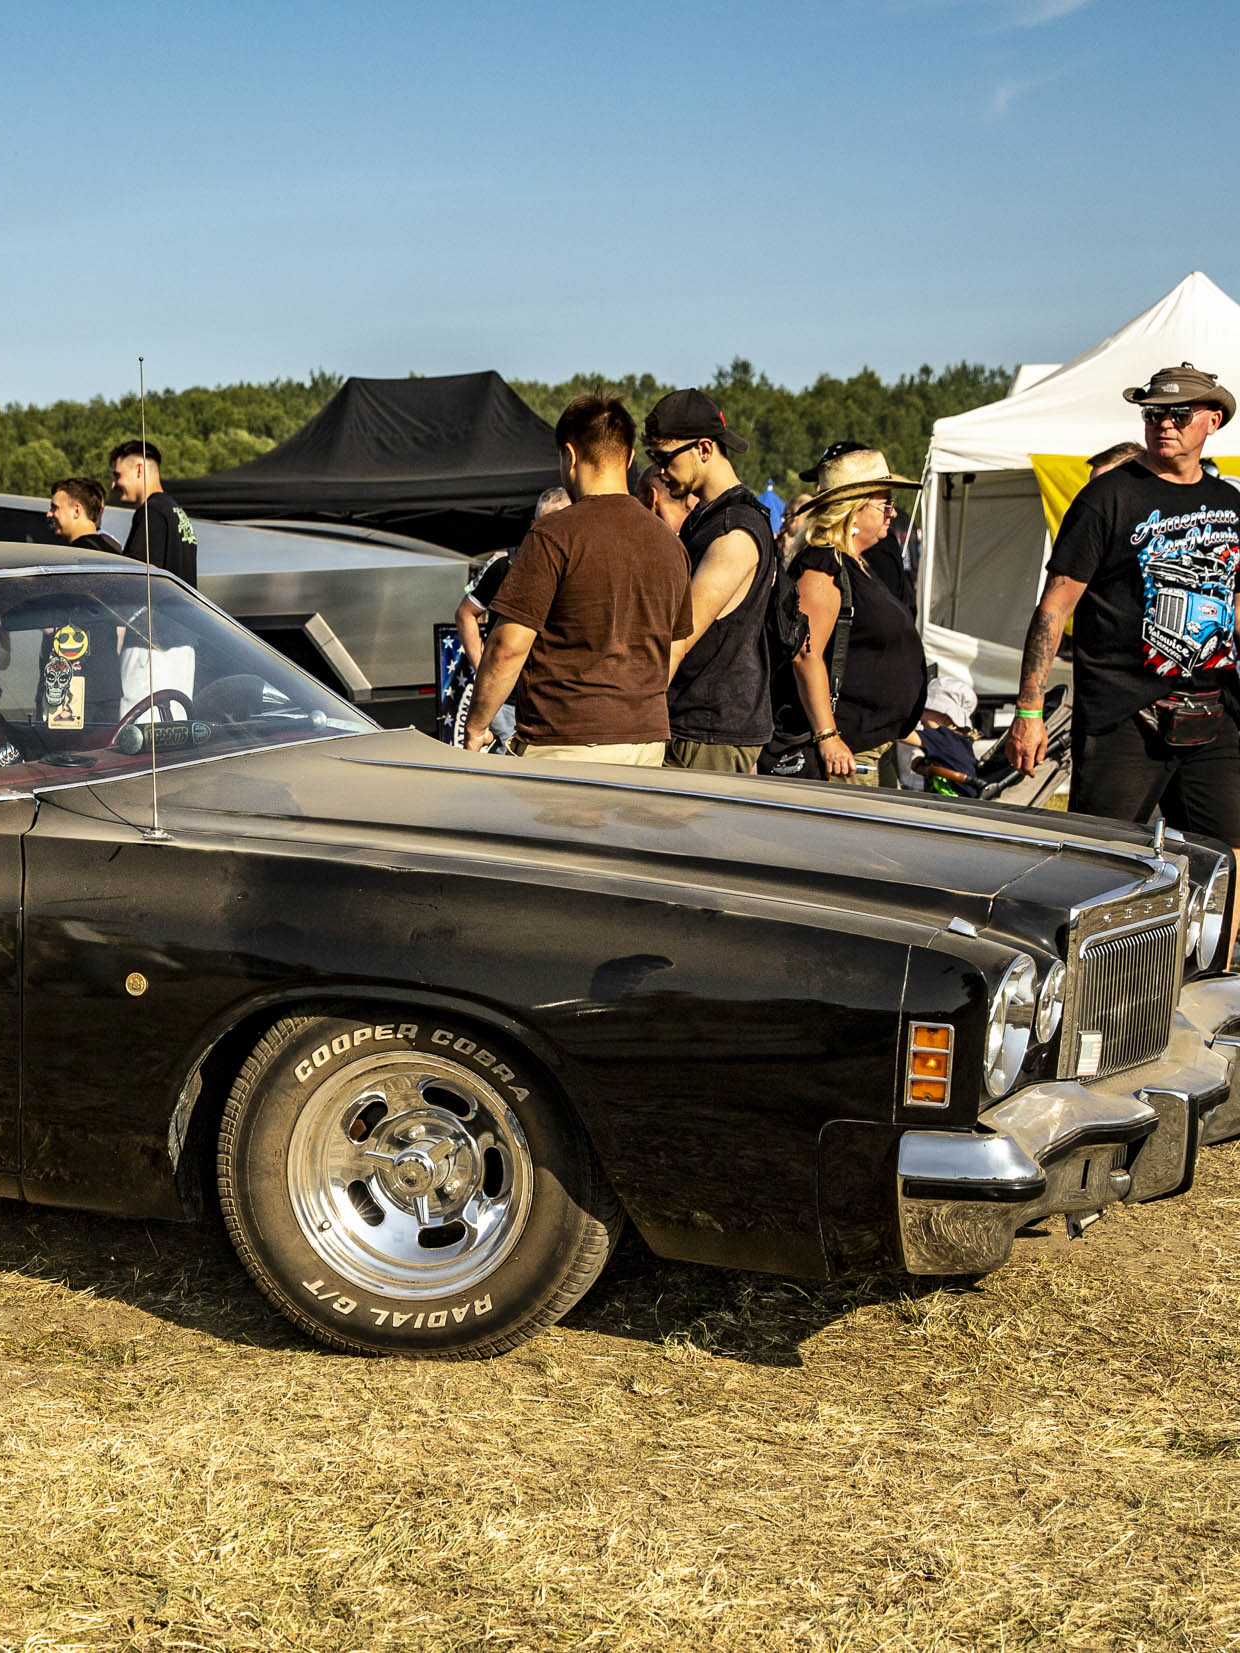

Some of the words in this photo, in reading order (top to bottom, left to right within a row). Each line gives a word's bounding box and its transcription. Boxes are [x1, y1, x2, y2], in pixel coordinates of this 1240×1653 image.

[1130, 504, 1239, 545] American
[294, 1023, 419, 1083] COOPER
[430, 1028, 531, 1103] COBRA
[301, 1279, 358, 1316] G/T
[369, 1293, 493, 1329] RADIAL
